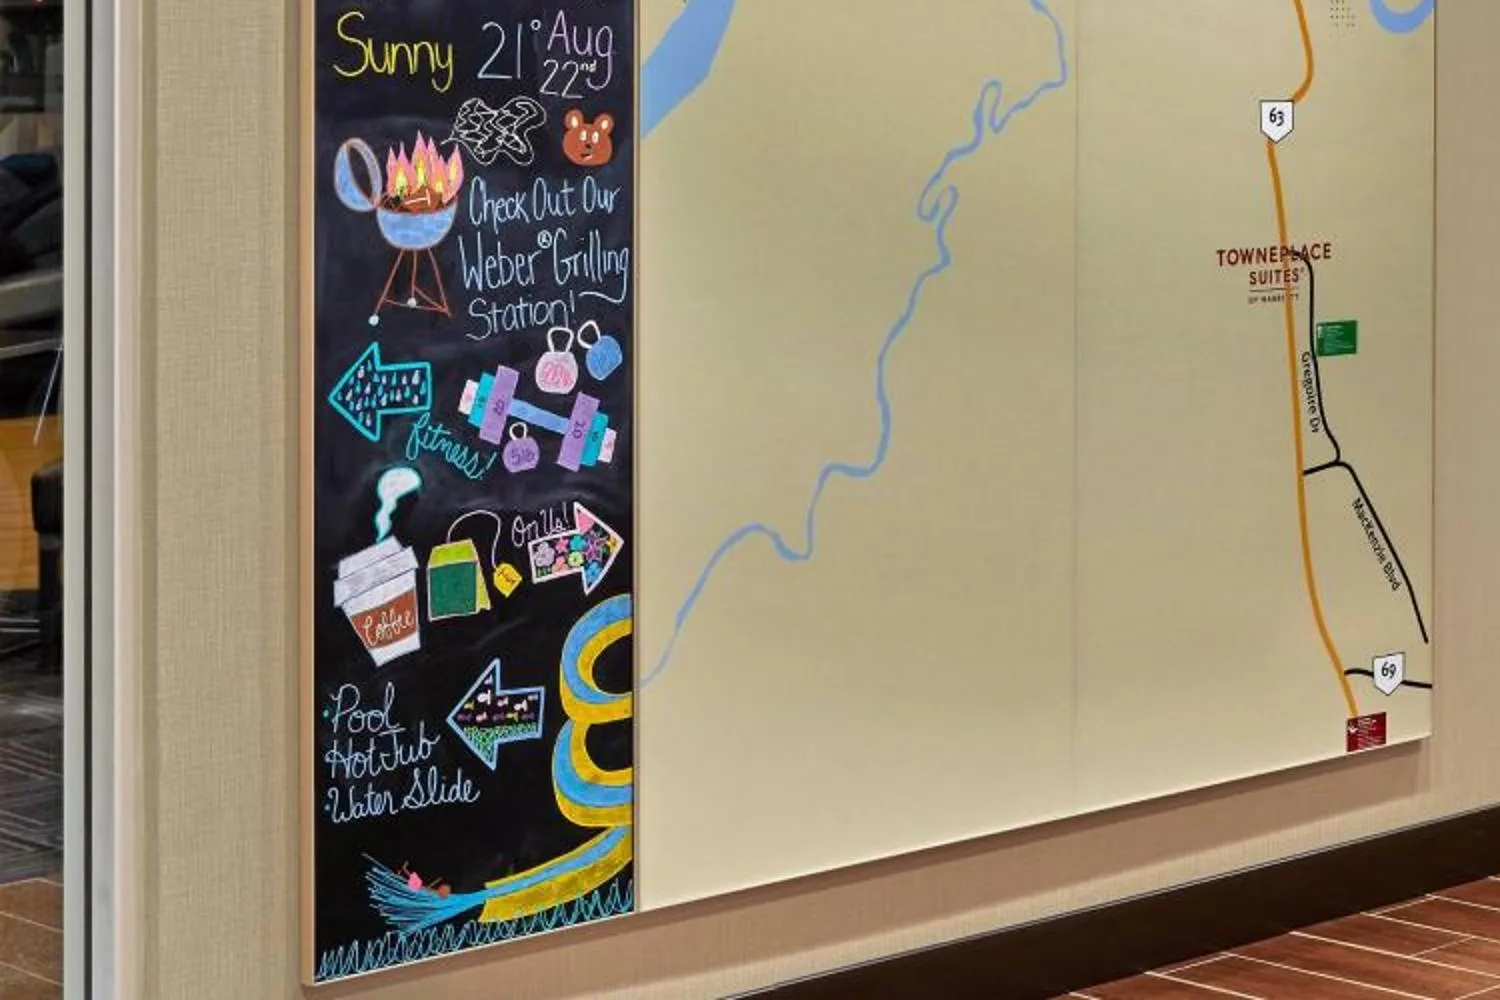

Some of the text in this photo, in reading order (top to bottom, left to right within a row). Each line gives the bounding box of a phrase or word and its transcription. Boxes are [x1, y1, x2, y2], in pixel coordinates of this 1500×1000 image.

[333, 10, 454, 93] Sunny
[547, 9, 614, 91] Aug
[1268, 107, 1285, 127] 63
[468, 175, 625, 228] Check Out Our
[552, 226, 630, 304] Grilling
[1216, 242, 1333, 267] TOWNEPLACE
[465, 290, 578, 342] Station!
[1301, 351, 1320, 433] Gregoire Dr
[1383, 561, 1402, 591] Blvd
[1381, 661, 1397, 679] 69
[331, 681, 400, 733] Pool
[324, 719, 440, 779] Hot Tub
[327, 766, 481, 824] Water Slide
